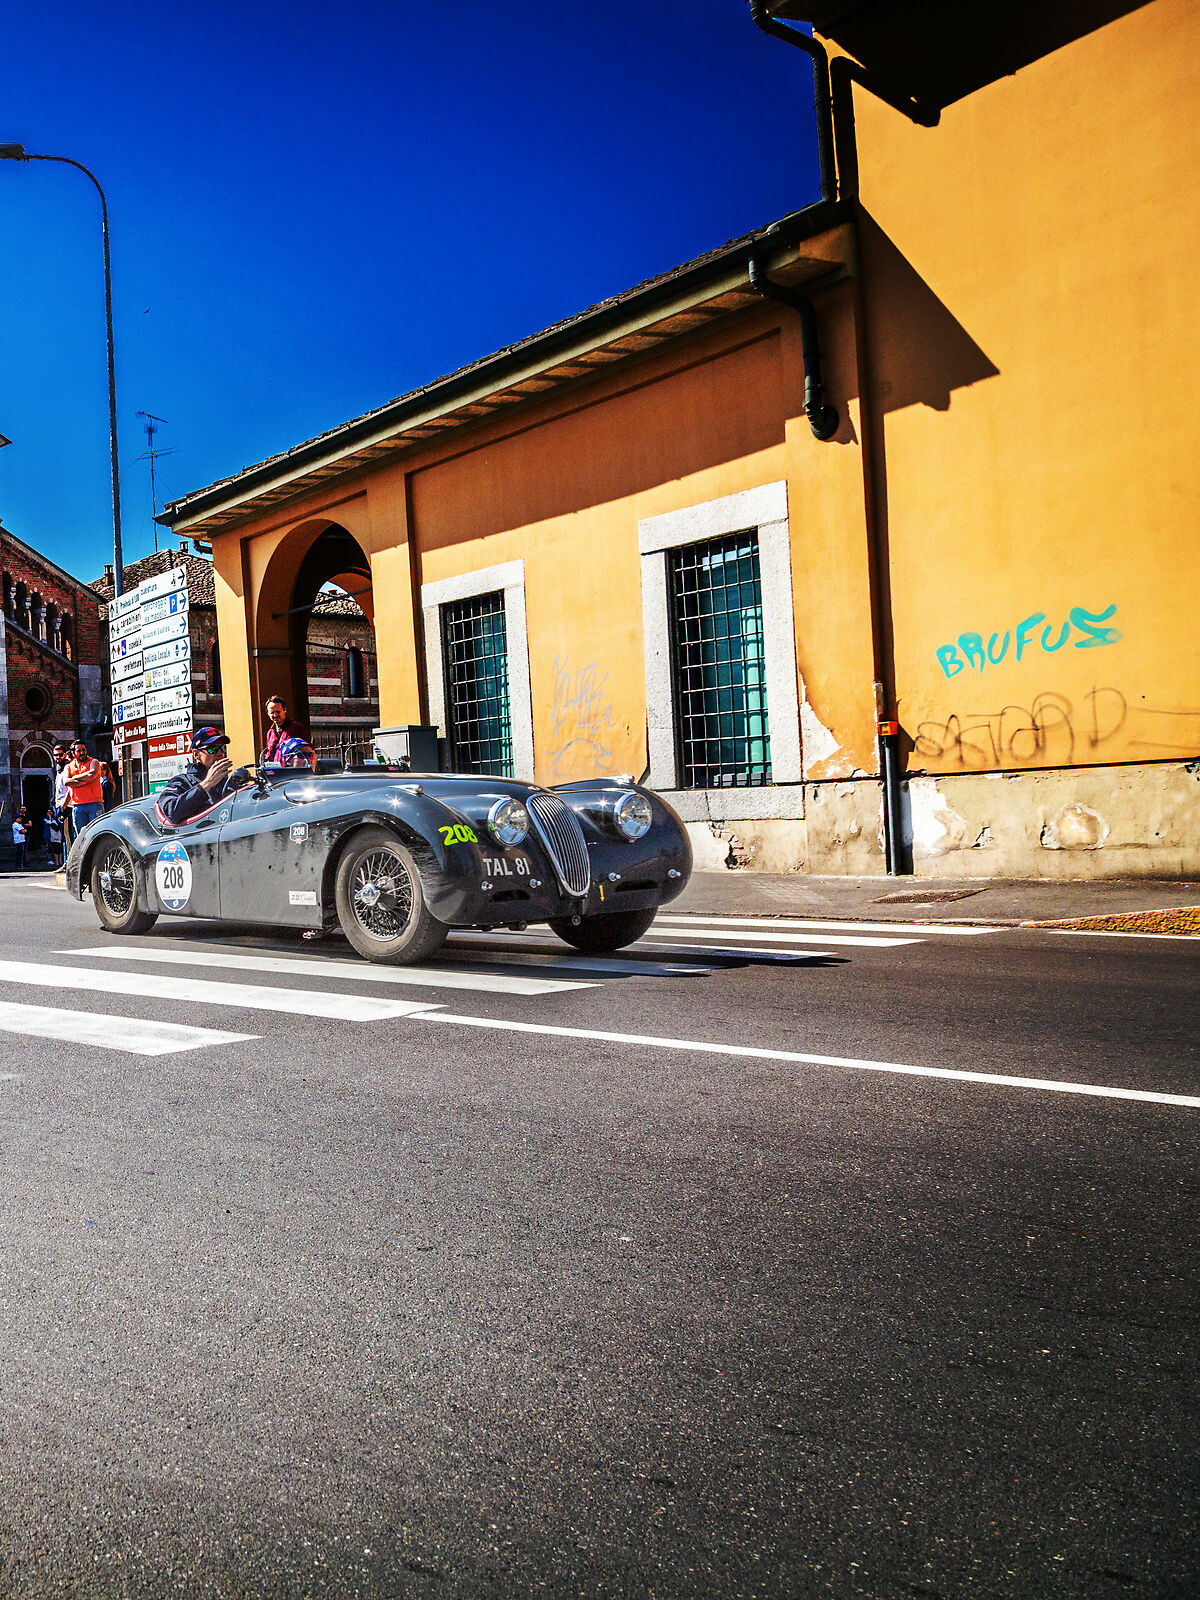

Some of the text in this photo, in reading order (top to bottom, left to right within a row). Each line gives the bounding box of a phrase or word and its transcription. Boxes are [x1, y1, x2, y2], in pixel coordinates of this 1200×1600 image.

[292, 826, 305, 836] 208
[438, 823, 479, 846] 208
[163, 866, 184, 889] 208
[482, 857, 531, 877] TAL 81
